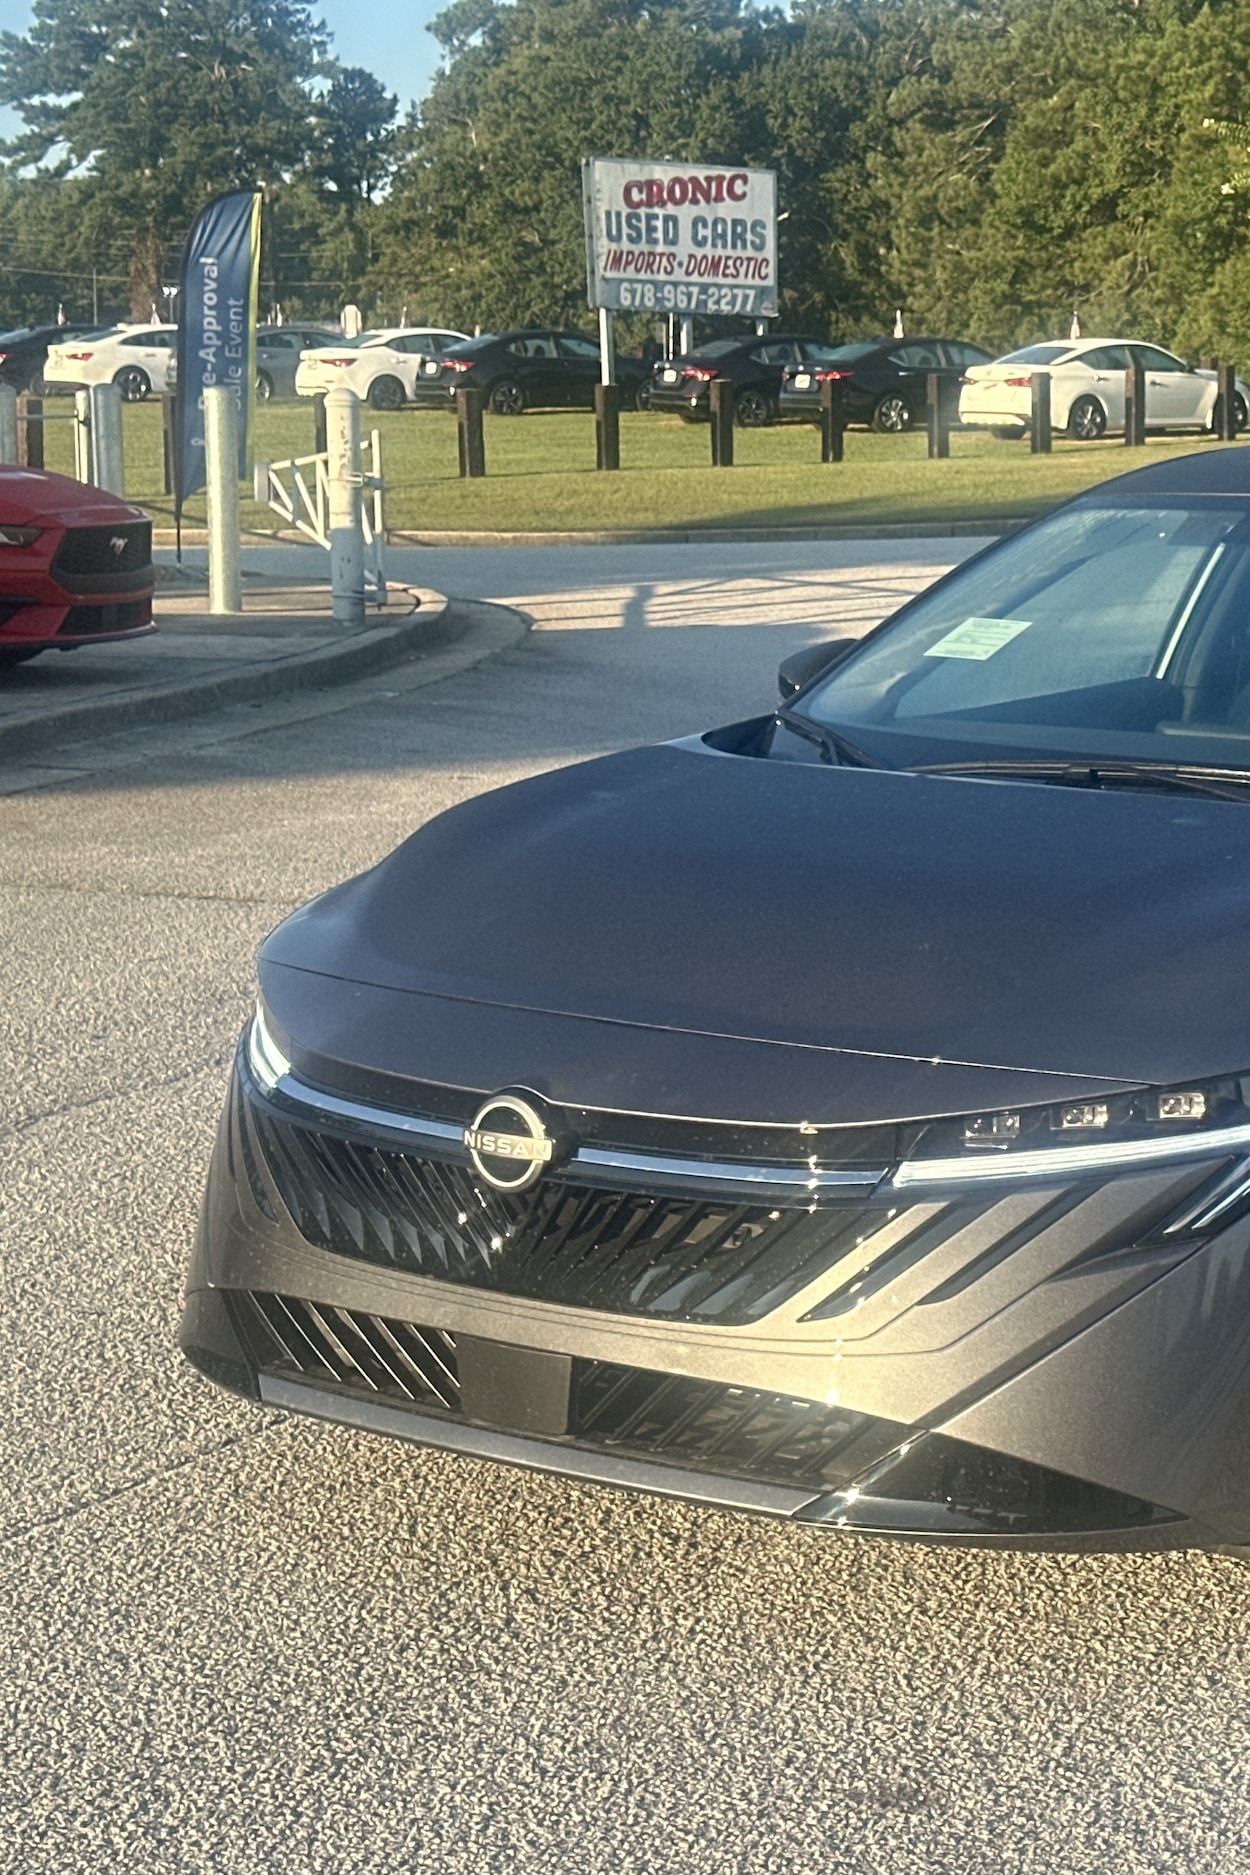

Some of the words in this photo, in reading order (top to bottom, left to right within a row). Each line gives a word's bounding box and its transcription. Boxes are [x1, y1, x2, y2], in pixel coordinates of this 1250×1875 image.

[623, 173, 748, 209] CRONIC
[605, 210, 679, 246] USED
[691, 215, 766, 251] CARS
[604, 250, 676, 276] IMPORTS
[685, 254, 769, 280] DOMESTIC
[620, 283, 755, 313] 678-967-2277
[225, 297, 244, 358] Event
[464, 1130, 551, 1160] NISSAN
